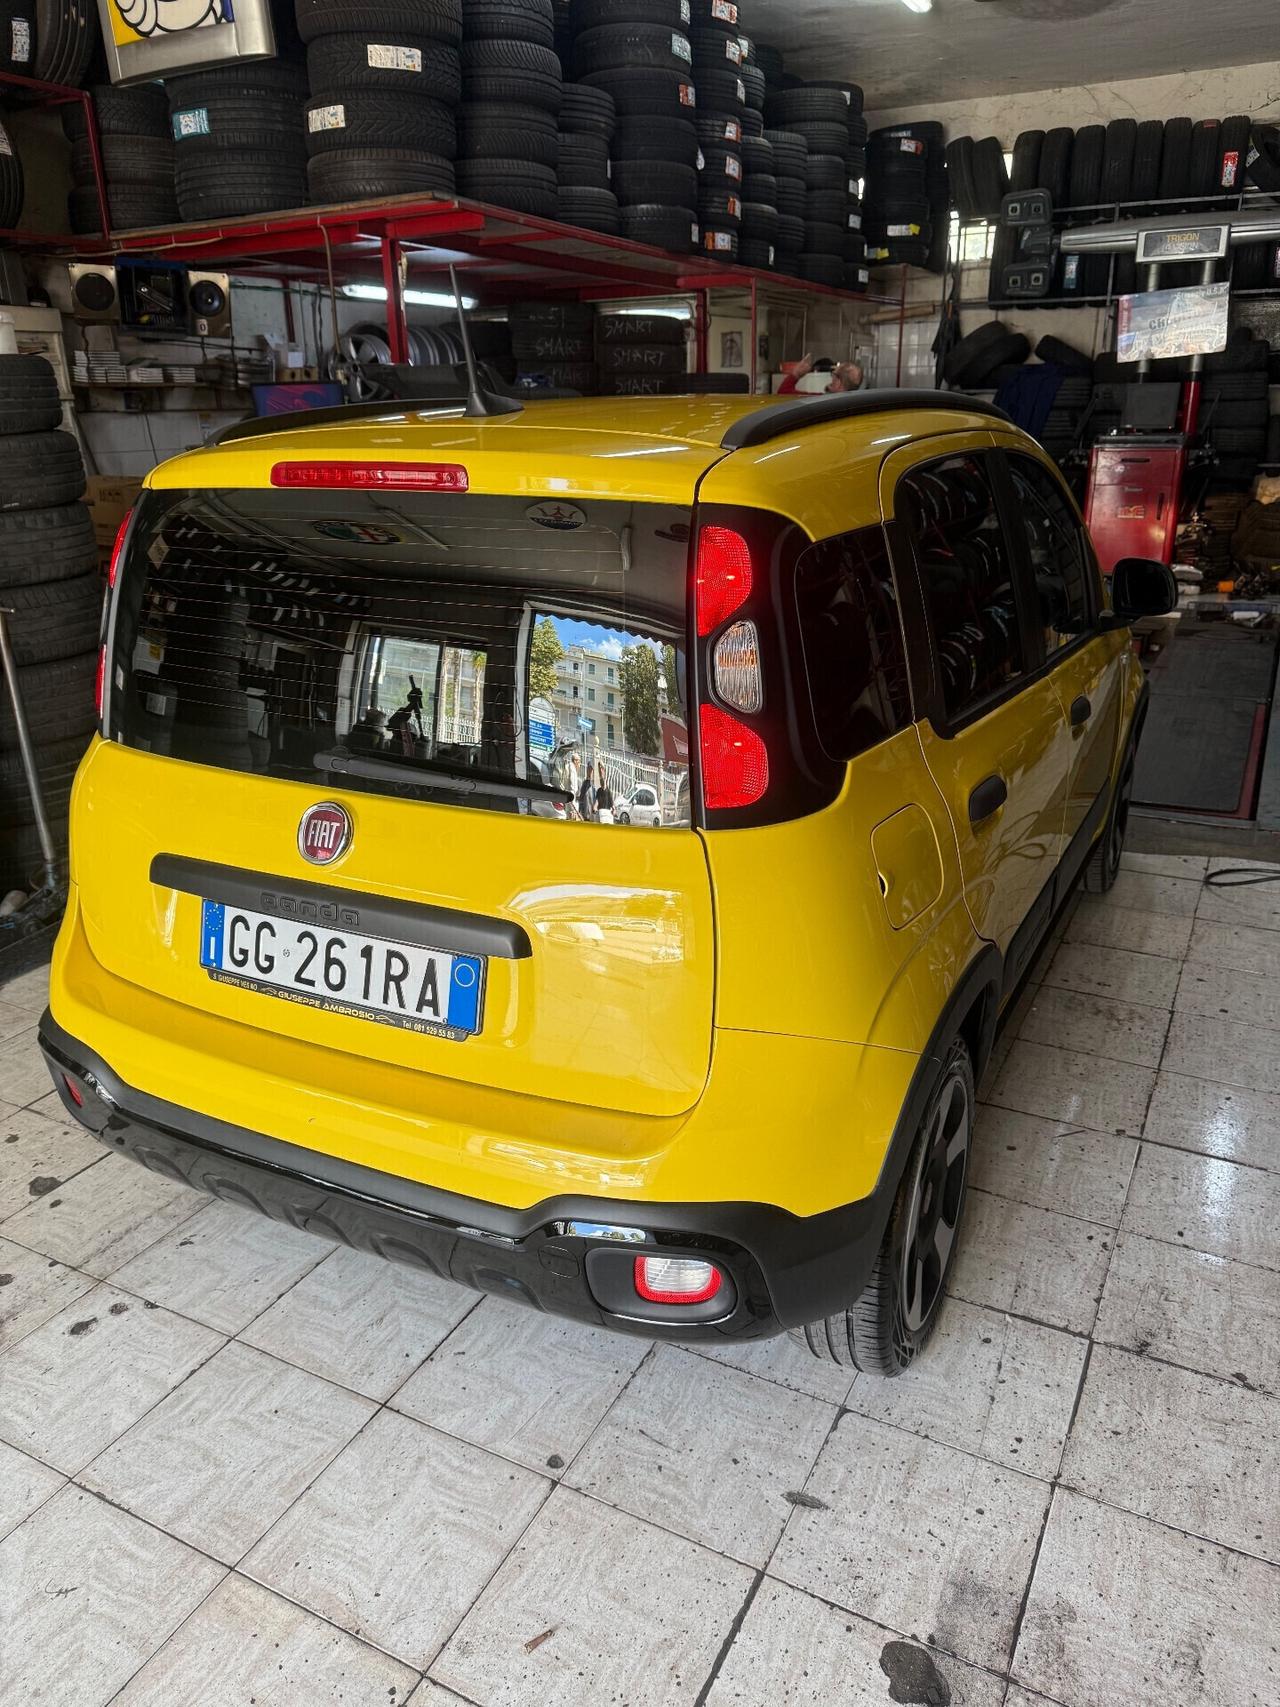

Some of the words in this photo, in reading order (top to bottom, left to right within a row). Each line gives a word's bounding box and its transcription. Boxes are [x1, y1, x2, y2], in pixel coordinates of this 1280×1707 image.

[1167, 232, 1200, 243] TRIGON
[307, 820, 340, 849] FIAT
[260, 892, 360, 926] panda
[228, 914, 276, 974] GG
[293, 930, 441, 1018] 261RA
[278, 991, 320, 1008] GIUSEPPE
[322, 1003, 375, 1020] AMBROSIO
[413, 1023, 424, 1032] 081
[426, 1026, 437, 1035] 529
[438, 1029, 446, 1037] 55
[447, 1031, 455, 1040] 83
